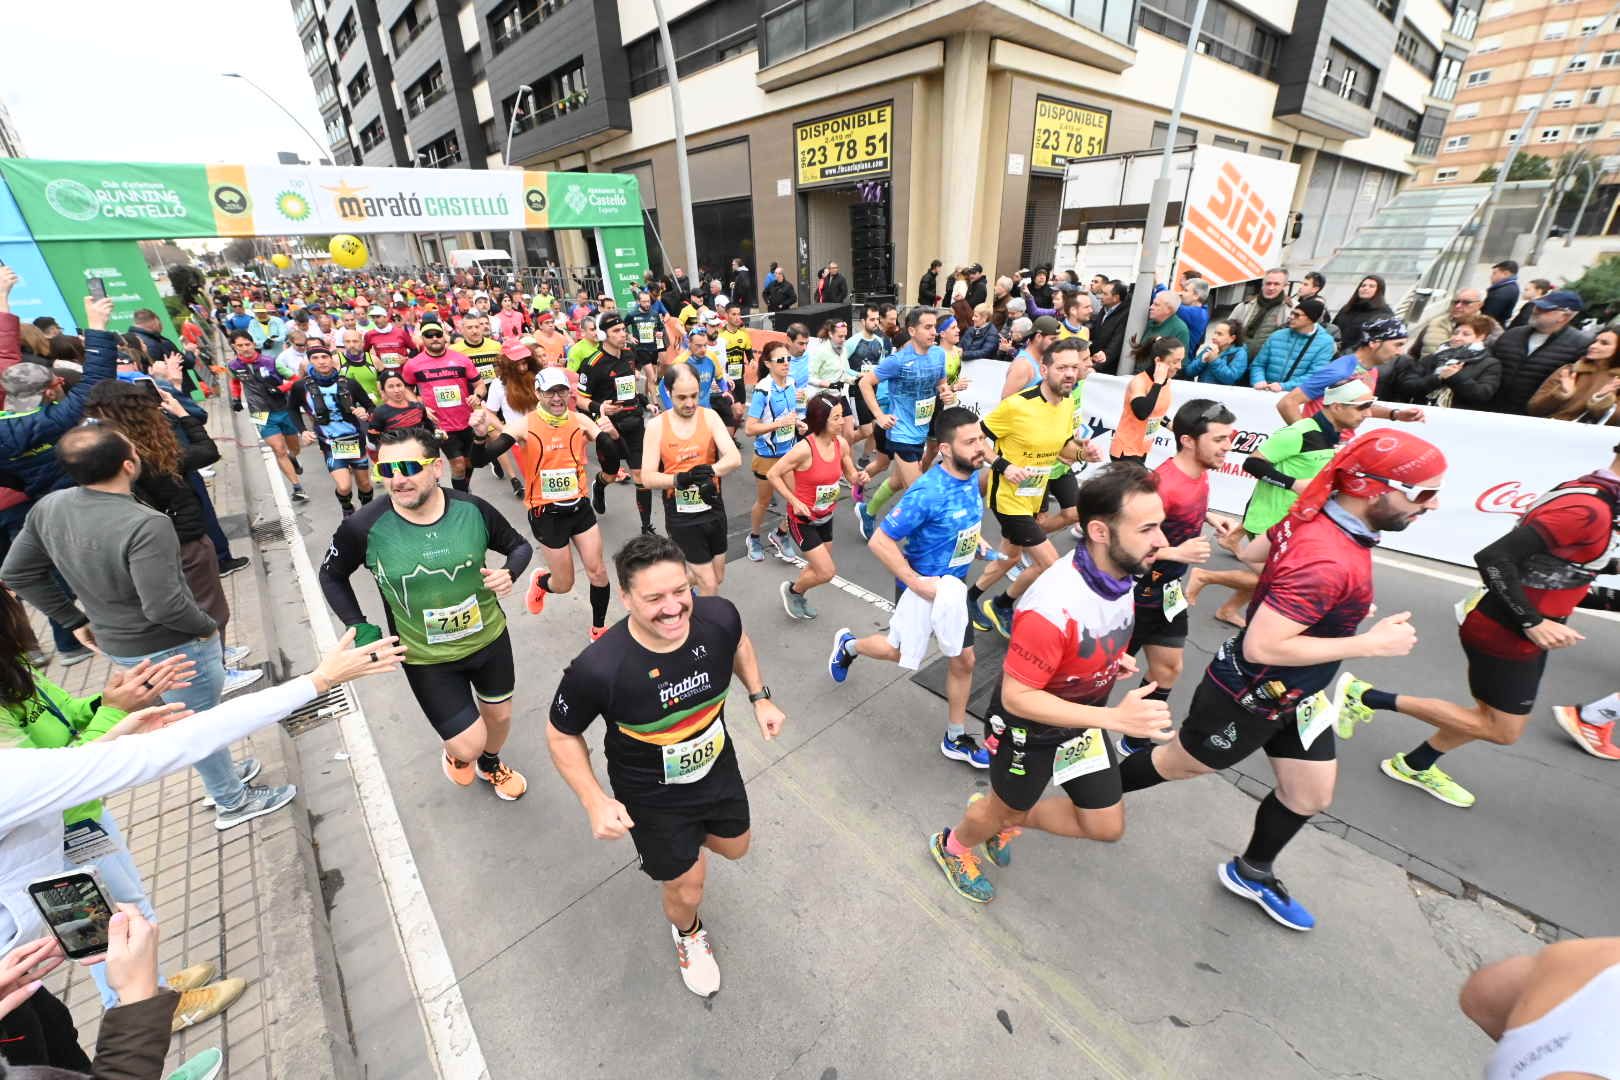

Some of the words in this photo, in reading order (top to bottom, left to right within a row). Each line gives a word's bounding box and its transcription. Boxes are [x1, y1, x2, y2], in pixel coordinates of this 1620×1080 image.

[800, 109, 886, 140] DISPONIBLE
[1039, 103, 1105, 128] DISPONIBLE
[806, 145, 828, 167] 23
[834, 139, 857, 162] 78
[864, 132, 888, 156] 51
[1041, 128, 1060, 151] 23
[1066, 132, 1083, 154] 78
[1087, 136, 1103, 156] 51
[95, 188, 180, 202] RUNNING
[338, 190, 423, 217] marató
[424, 192, 510, 217] CASTELLÓ
[440, 391, 456, 400] 878
[549, 476, 570, 489] 866
[438, 610, 470, 630] 715
[660, 670, 709, 703] triatlón
[679, 741, 714, 769] 508
